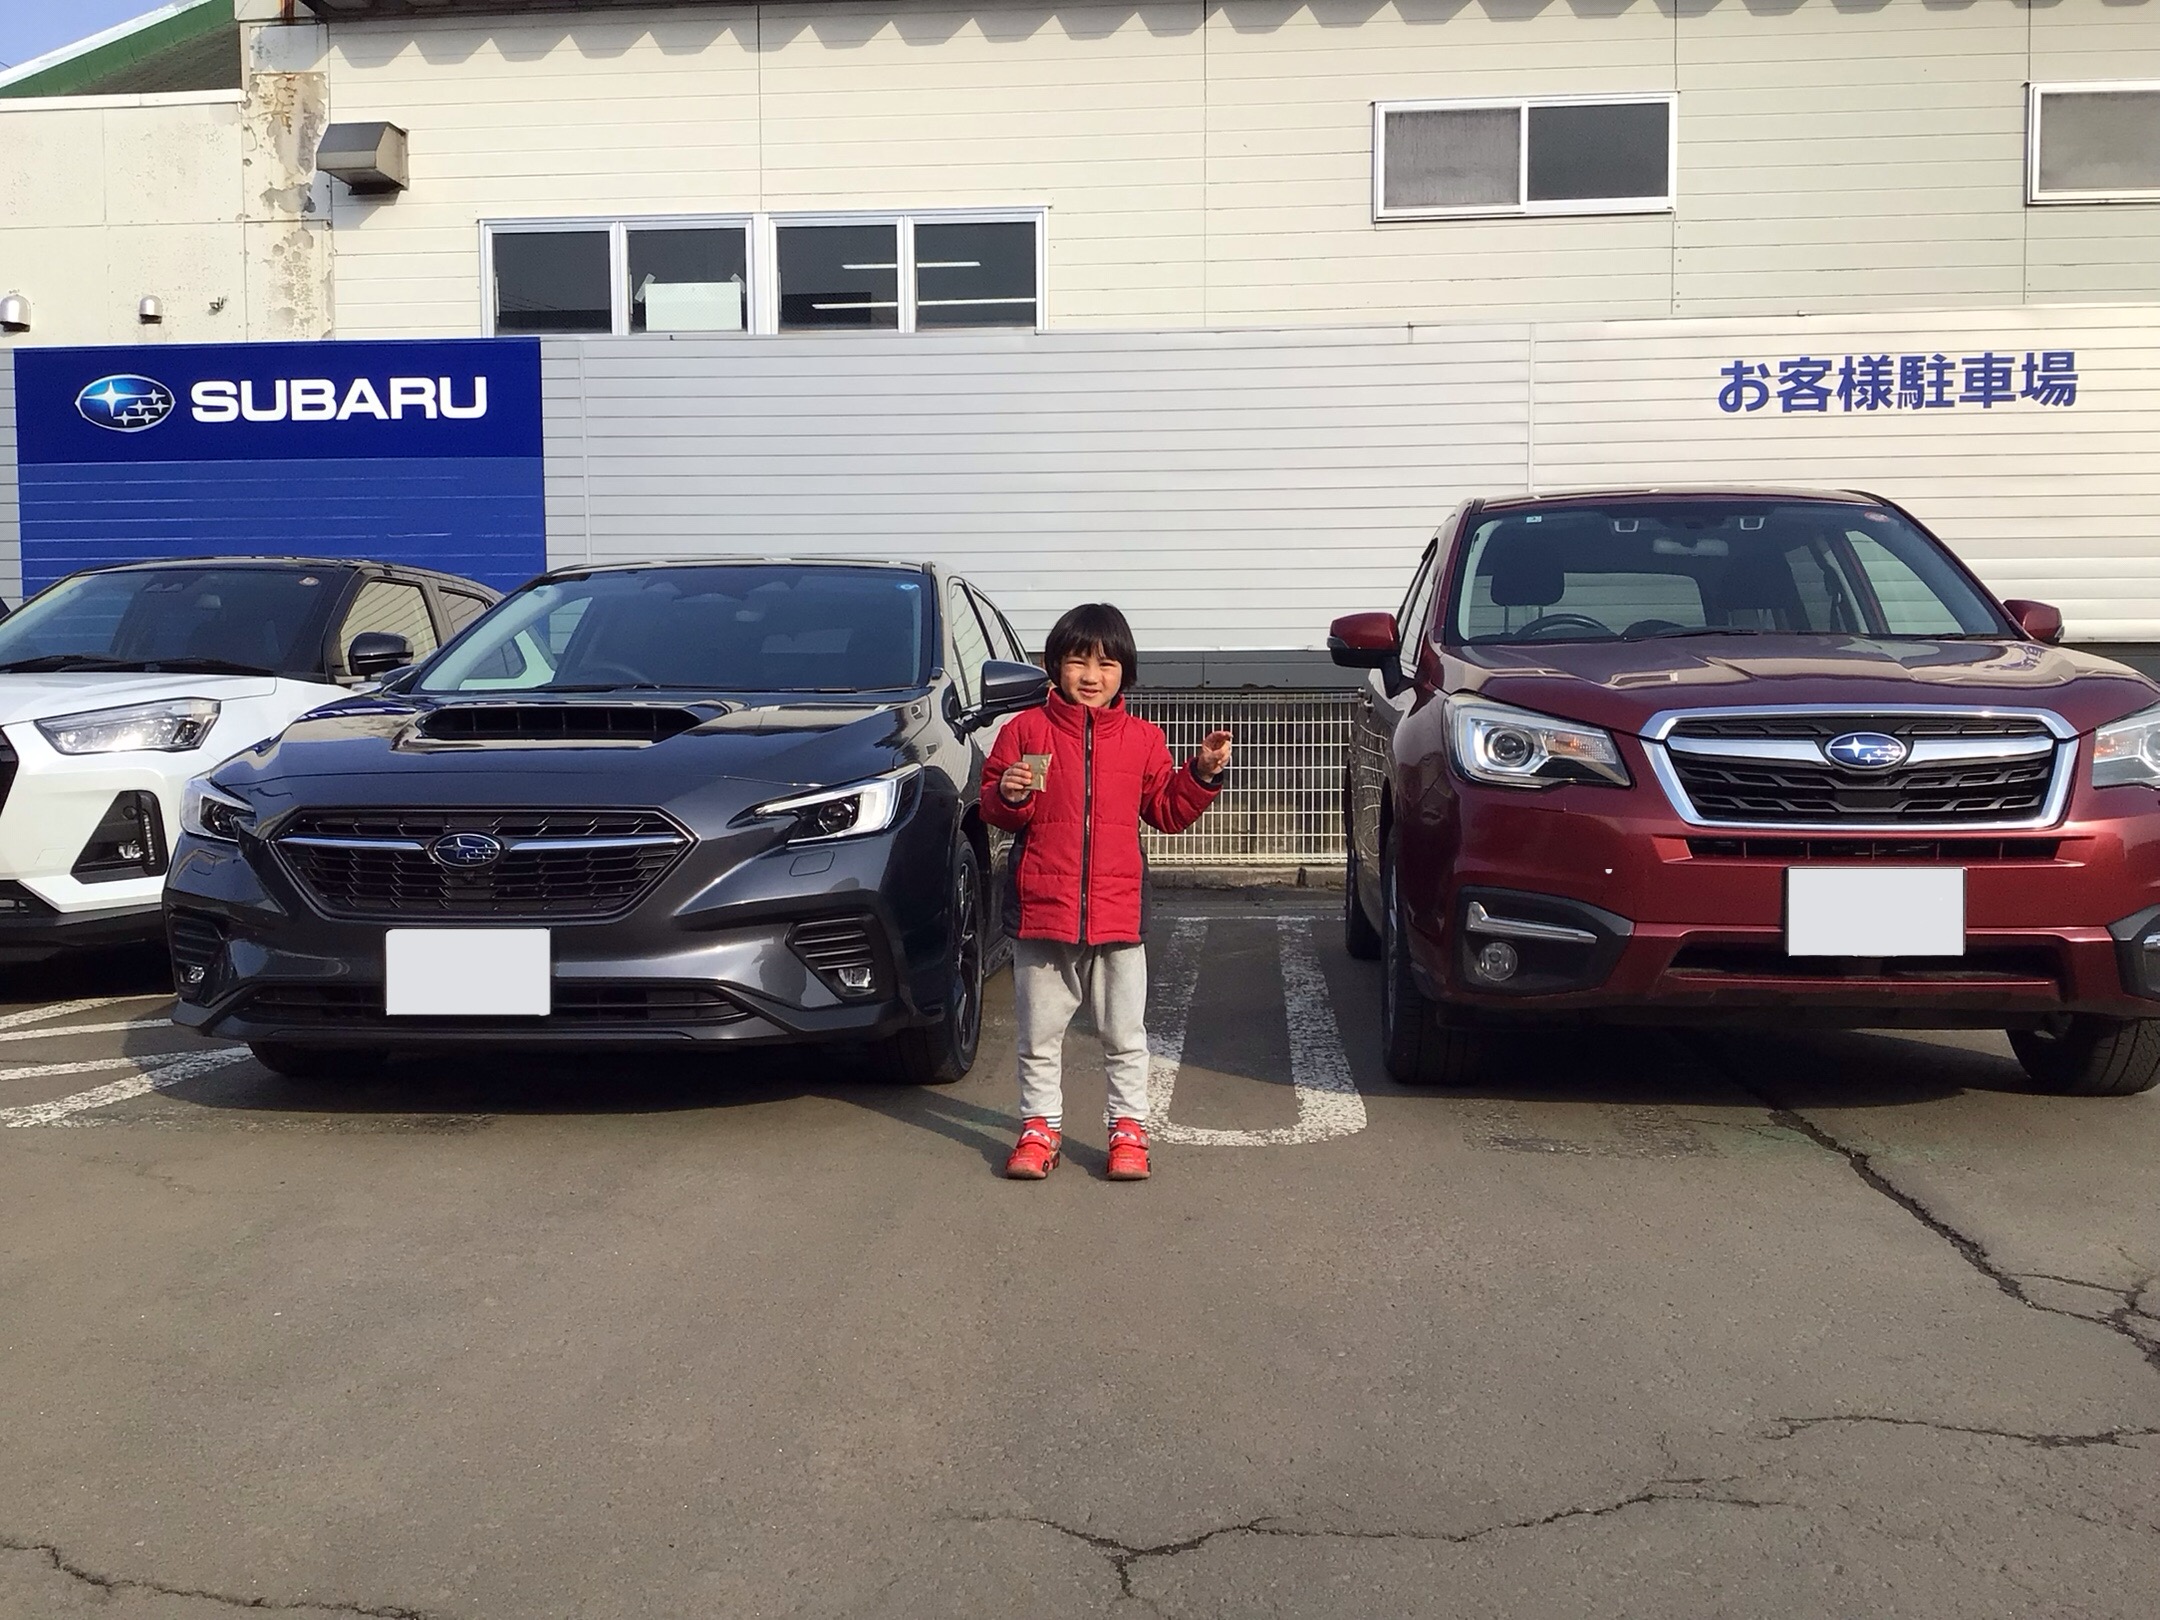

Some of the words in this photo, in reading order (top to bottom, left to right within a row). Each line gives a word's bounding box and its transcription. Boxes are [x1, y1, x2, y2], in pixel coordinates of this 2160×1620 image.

[191, 376, 488, 422] SUBARU
[1717, 351, 2079, 413] お客様駐車場
